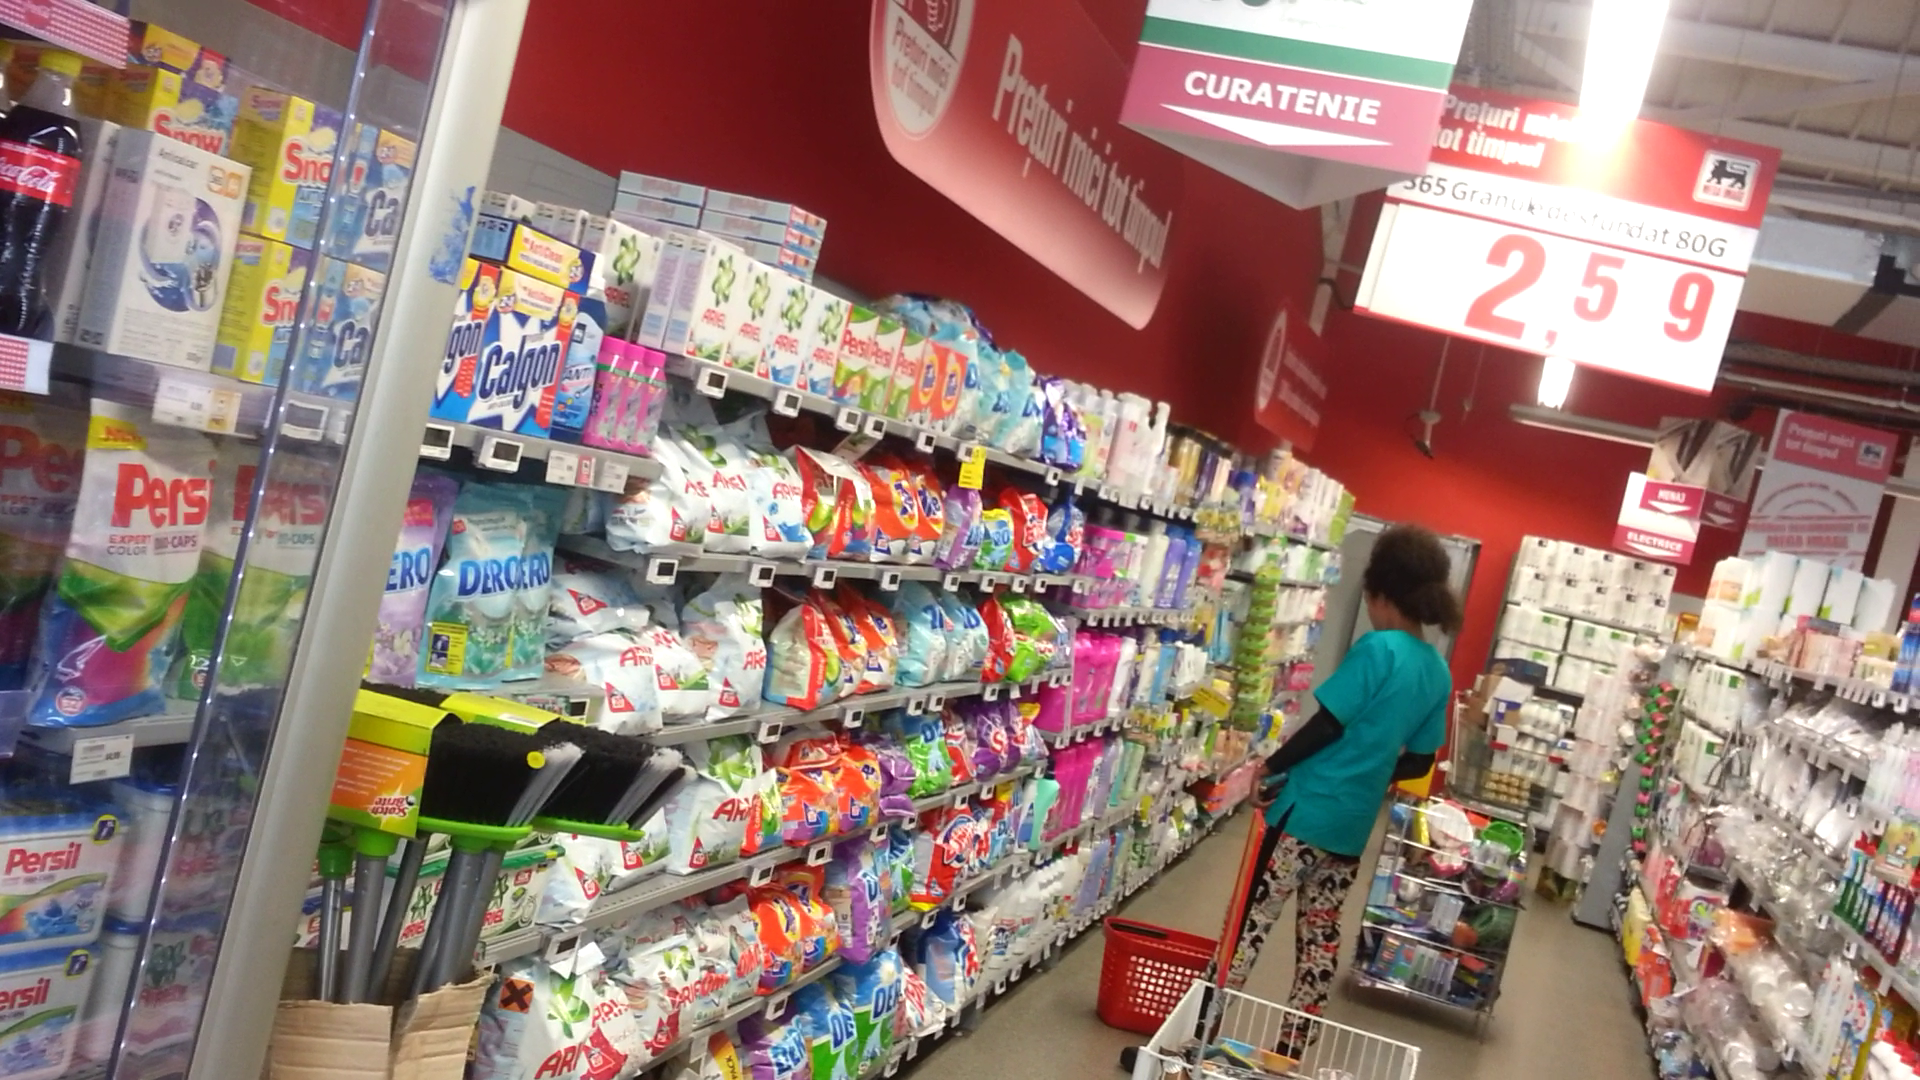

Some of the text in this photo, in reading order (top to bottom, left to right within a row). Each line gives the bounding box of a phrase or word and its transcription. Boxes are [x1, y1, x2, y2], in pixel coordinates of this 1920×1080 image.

[1184, 71, 1381, 125] CURATENIE
[1063, 127, 1112, 212] mici
[1100, 161, 1132, 231] tot
[1675, 230, 1729, 258] 80G
[478, 335, 562, 410] Calgon
[106, 546, 148, 556] COLOR
[109, 534, 152, 545] EXPERT
[1627, 531, 1684, 553] ELECTRICE
[371, 805, 408, 818] Scotch
[5, 841, 82, 876] Persil
